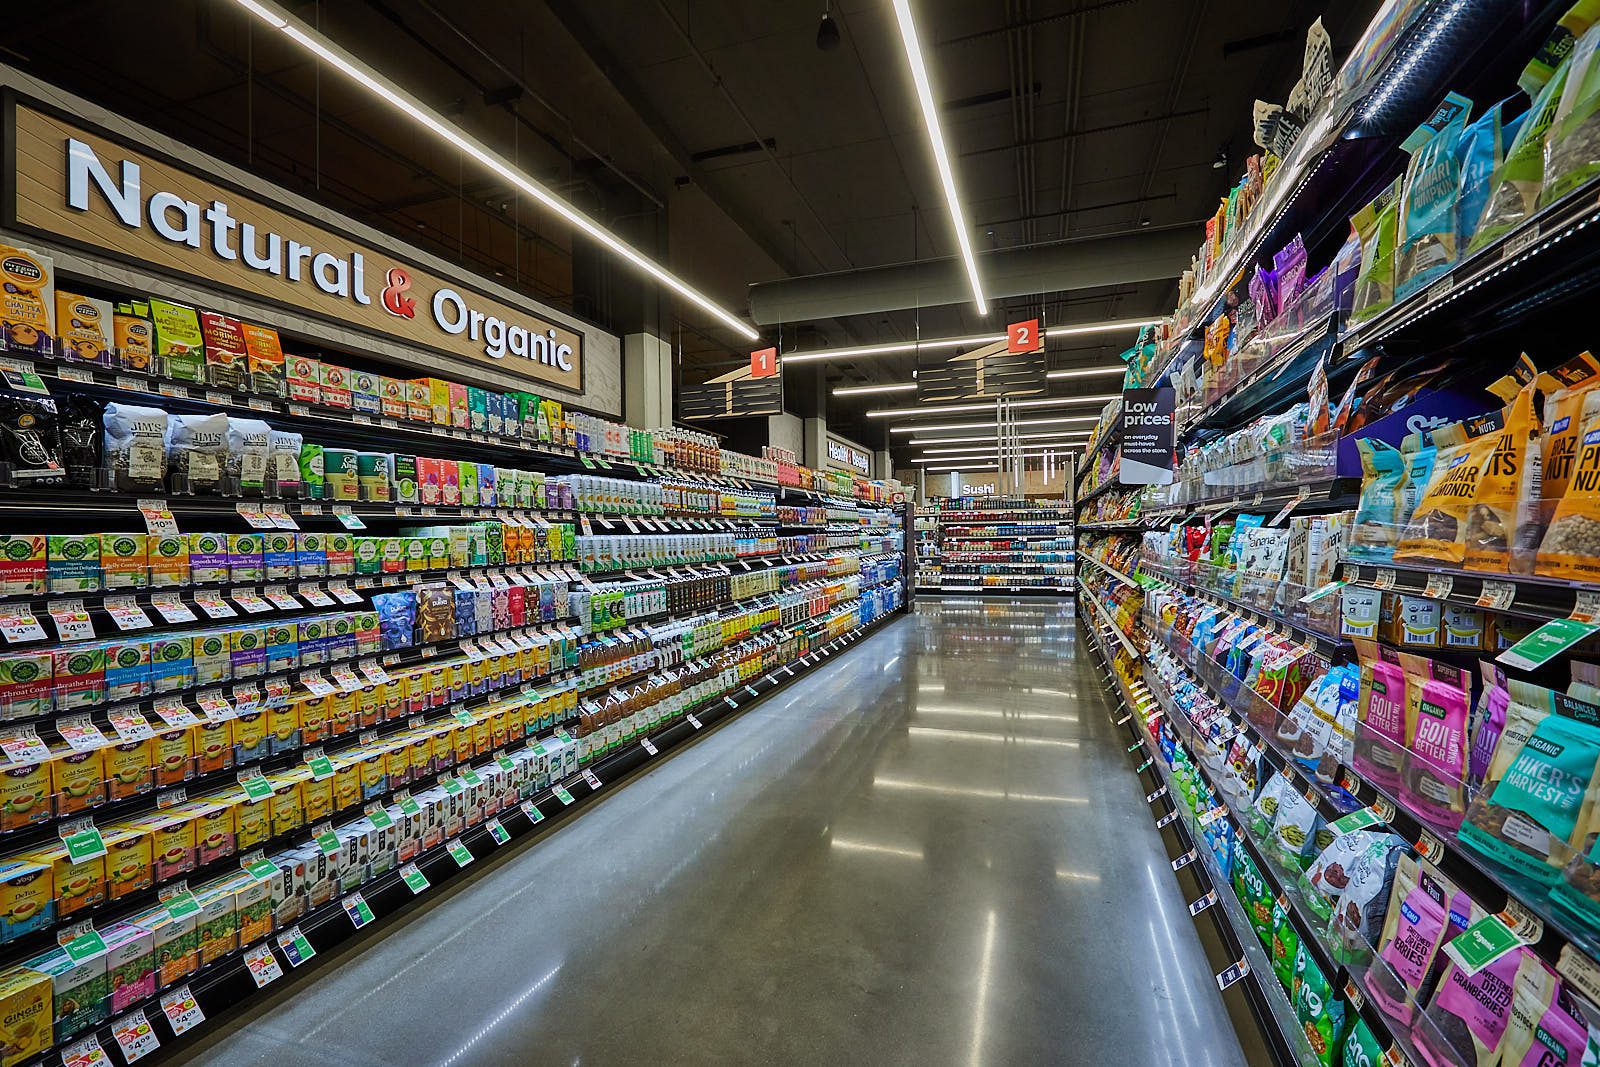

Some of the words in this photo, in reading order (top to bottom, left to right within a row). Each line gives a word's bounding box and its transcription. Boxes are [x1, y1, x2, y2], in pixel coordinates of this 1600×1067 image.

[1413, 178, 1453, 211] PUMPKIN
[65, 137, 372, 306] Natural
[380, 267, 417, 320] &
[430, 287, 574, 372] Organic
[1016, 327, 1030, 345] 2
[758, 353, 767, 371] 1
[1124, 400, 1158, 413] Low
[131, 422, 162, 431] JIM'S
[1124, 412, 1171, 428] prices
[1478, 420, 1496, 435] NUTS
[192, 432, 222, 441] JIM'S
[243, 432, 267, 441] JIM'S
[828, 441, 847, 462] Health
[1545, 454, 1575, 480] NUT
[962, 483, 995, 495] Sushi
[431, 598, 448, 607] pukka
[1536, 631, 1566, 645] Organic
[57, 680, 85, 689] Breathe
[85, 678, 103, 686] Easy
[3, 688, 29, 697] Throat
[30, 686, 48, 694] Coat
[1370, 694, 1391, 720] GOJI
[1422, 703, 1445, 718] ORGANIC
[1563, 698, 1597, 715] BALANCED
[1368, 714, 1391, 732] GETTER
[166, 731, 180, 740] yogi
[1419, 718, 1450, 748] GOJI
[1450, 728, 1461, 743] MIX
[1477, 726, 1498, 754] OJI
[121, 742, 137, 752] yogi
[1415, 738, 1446, 762] GETTER
[1446, 743, 1459, 765] SNACK
[70, 753, 87, 763] yogi
[114, 757, 127, 766] Cold
[127, 753, 146, 763] Season
[14, 767, 32, 778] yogi
[62, 770, 76, 779] Cold
[76, 765, 97, 775] Season
[1515, 754, 1584, 795] HIKER'S
[22, 777, 49, 790] Comfort
[1506, 770, 1564, 807] HARVEST
[169, 824, 183, 832] yogi
[73, 838, 95, 848] Organic
[120, 839, 136, 848] yogi
[120, 852, 138, 862] Ginger
[69, 865, 89, 876] Ginger
[15, 875, 35, 886] yogi
[15, 888, 37, 900] DeTox
[1427, 884, 1441, 902] FRUIT
[1404, 934, 1428, 956] DRIED
[1472, 930, 1496, 952] Organic
[1453, 971, 1504, 1019] CRANBERRIES
[1482, 978, 1510, 1009] DRIED
[3, 1001, 44, 1024] GINGER
[176, 1009, 196, 1024] $409
[128, 1035, 151, 1051] $409
[1537, 1029, 1566, 1060] ORGANIC
